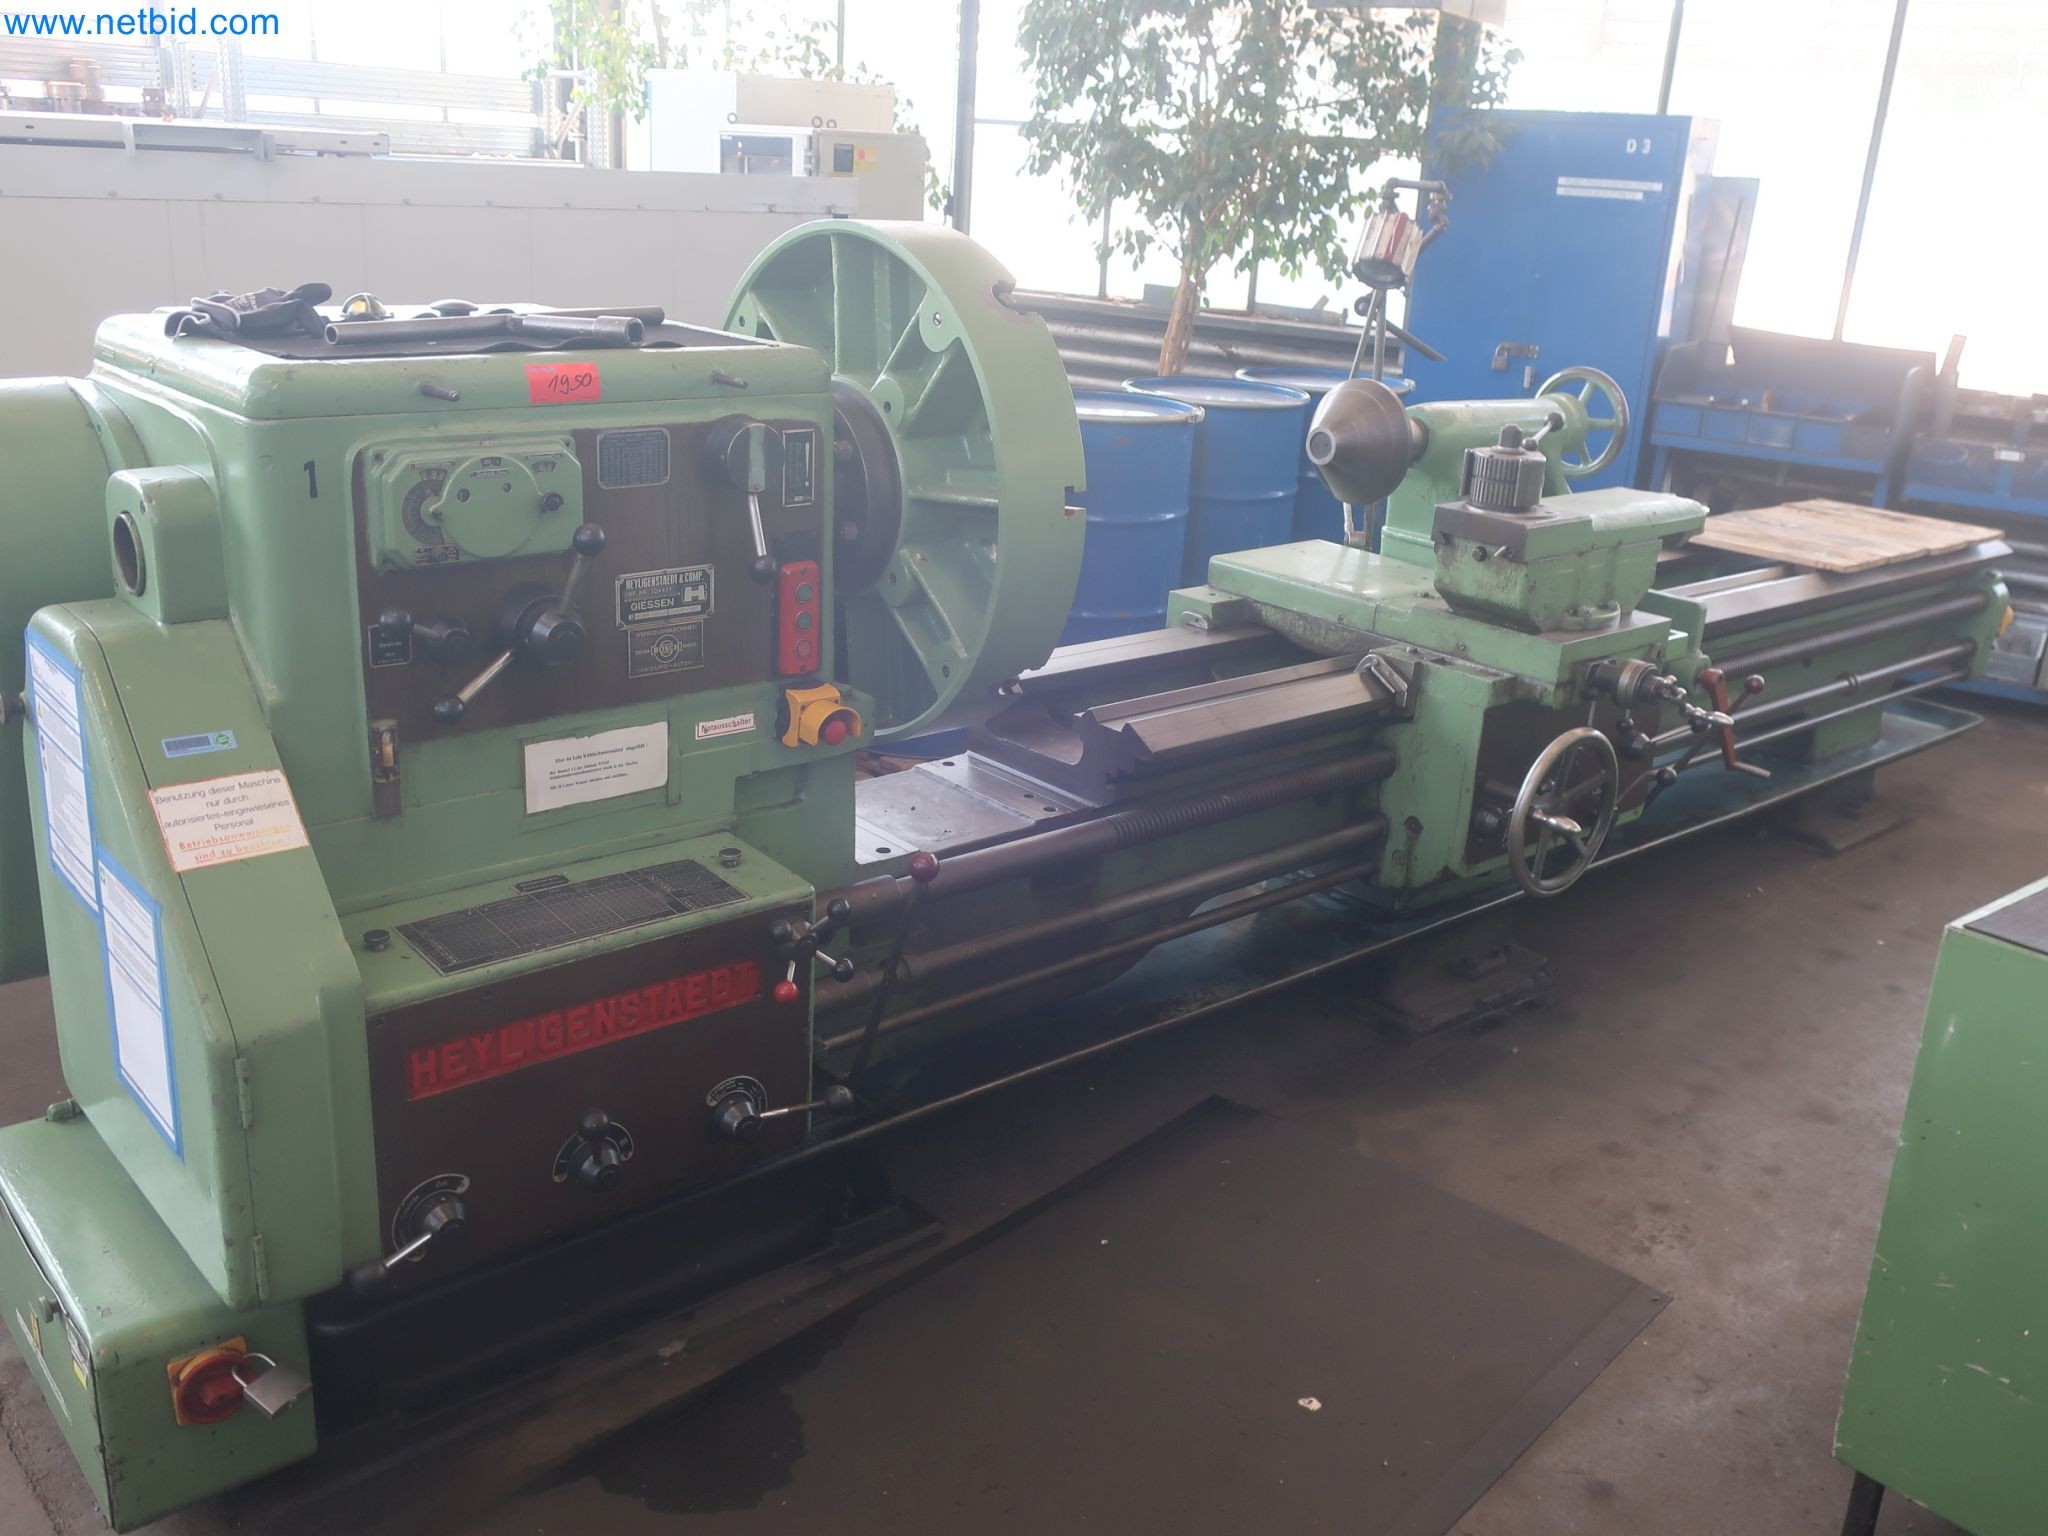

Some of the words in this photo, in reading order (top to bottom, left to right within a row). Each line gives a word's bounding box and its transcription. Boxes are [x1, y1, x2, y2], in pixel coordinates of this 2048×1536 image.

[548, 372, 593, 396] 1950
[304, 460, 318, 499] 1
[625, 574, 677, 591] HEYLIGENSTAEDT
[679, 575, 685, 584] &
[684, 570, 705, 583] COMP.
[630, 598, 674, 611] GIESSEN
[701, 718, 752, 733] Notausschalter
[155, 789, 206, 805] Benutzung
[208, 784, 236, 796] dieser
[238, 776, 281, 791] Maschine
[206, 801, 221, 809] nur
[223, 794, 249, 806] durch
[165, 800, 290, 829] autorisiertes-eingewiesenes
[213, 818, 255, 832] Personal
[195, 846, 217, 862] sind
[221, 843, 233, 856] zu
[408, 961, 758, 1094] HEYLIGENSTAEDT
